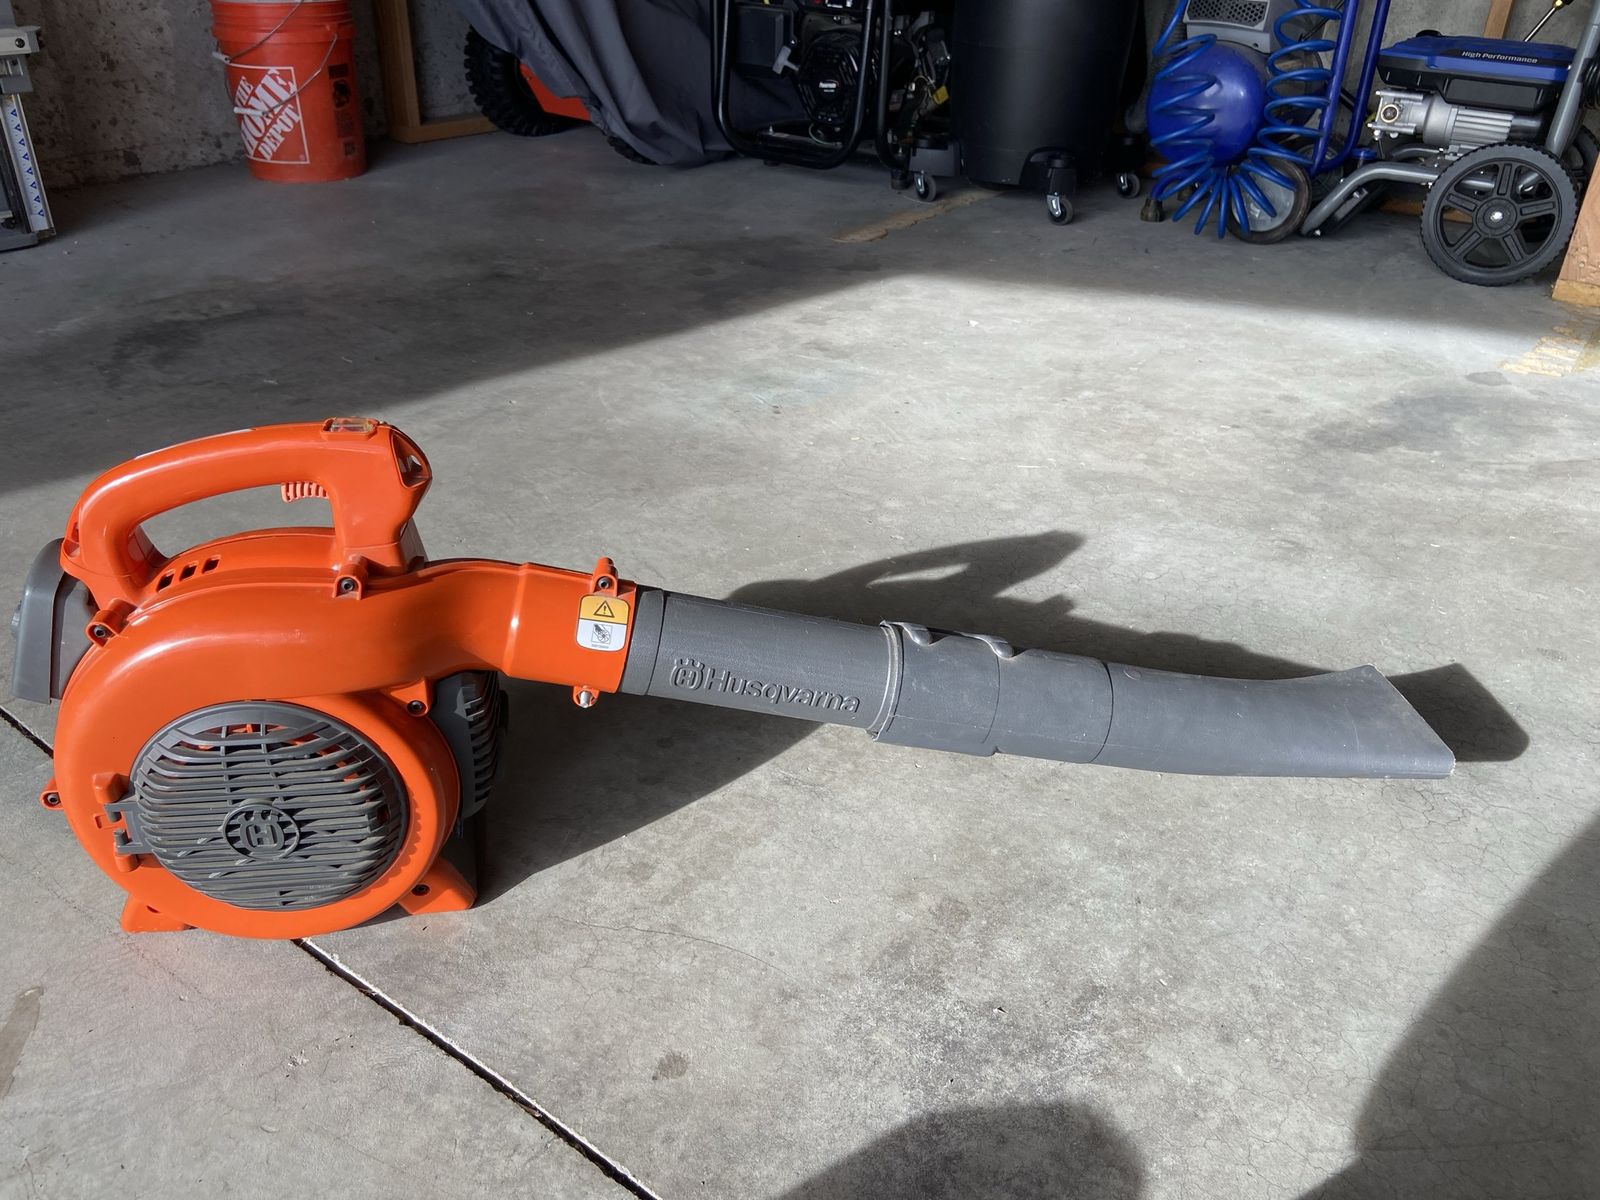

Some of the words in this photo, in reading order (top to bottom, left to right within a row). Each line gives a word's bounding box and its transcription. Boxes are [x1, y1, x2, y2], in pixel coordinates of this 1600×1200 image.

[1482, 53, 1538, 63] Performance
[235, 76, 254, 107] THE
[257, 104, 300, 160] DEPOT
[704, 667, 860, 713] Husqvarna
